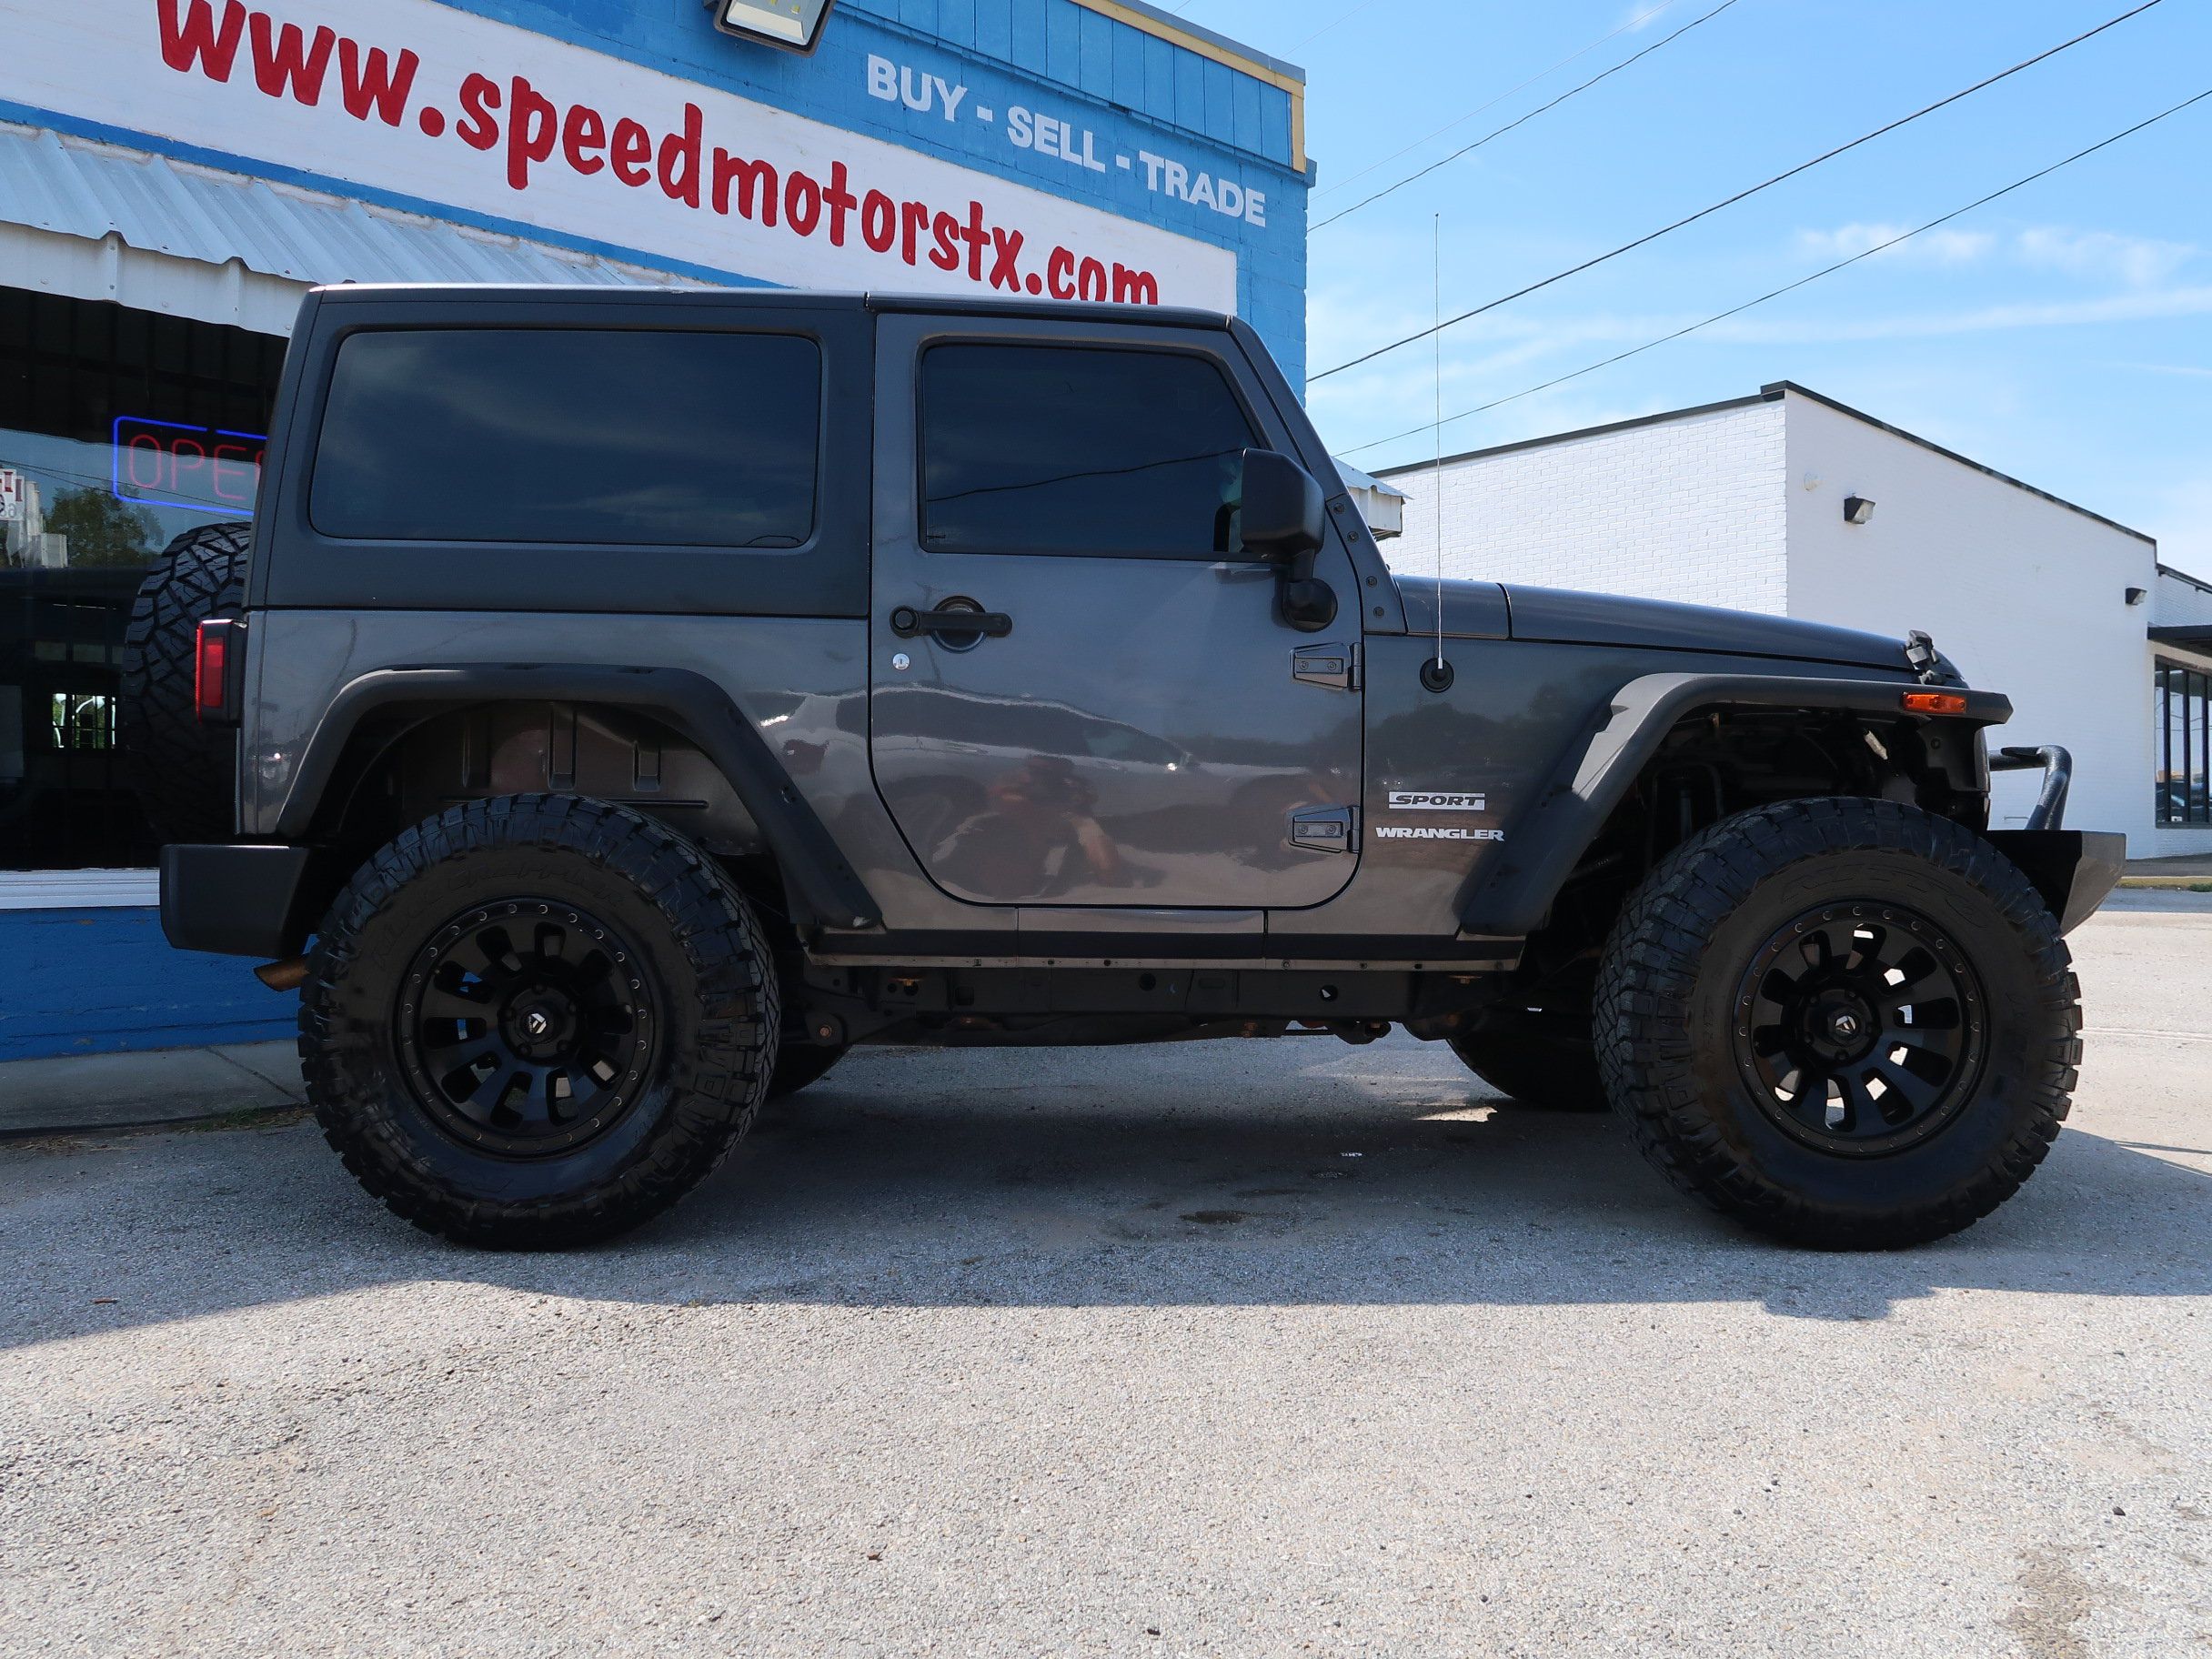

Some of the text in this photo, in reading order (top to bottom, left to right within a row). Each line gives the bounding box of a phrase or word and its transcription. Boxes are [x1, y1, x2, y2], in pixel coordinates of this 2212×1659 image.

[158, 0, 1159, 306] www.speedmotorstx.com
[868, 55, 968, 122] BUY
[1007, 106, 1106, 173] SELL
[1139, 150, 1266, 227] TRADE
[128, 433, 265, 501] OPE
[1375, 827, 1505, 841] WRANGLER
[1390, 793, 1484, 808] SPORT
